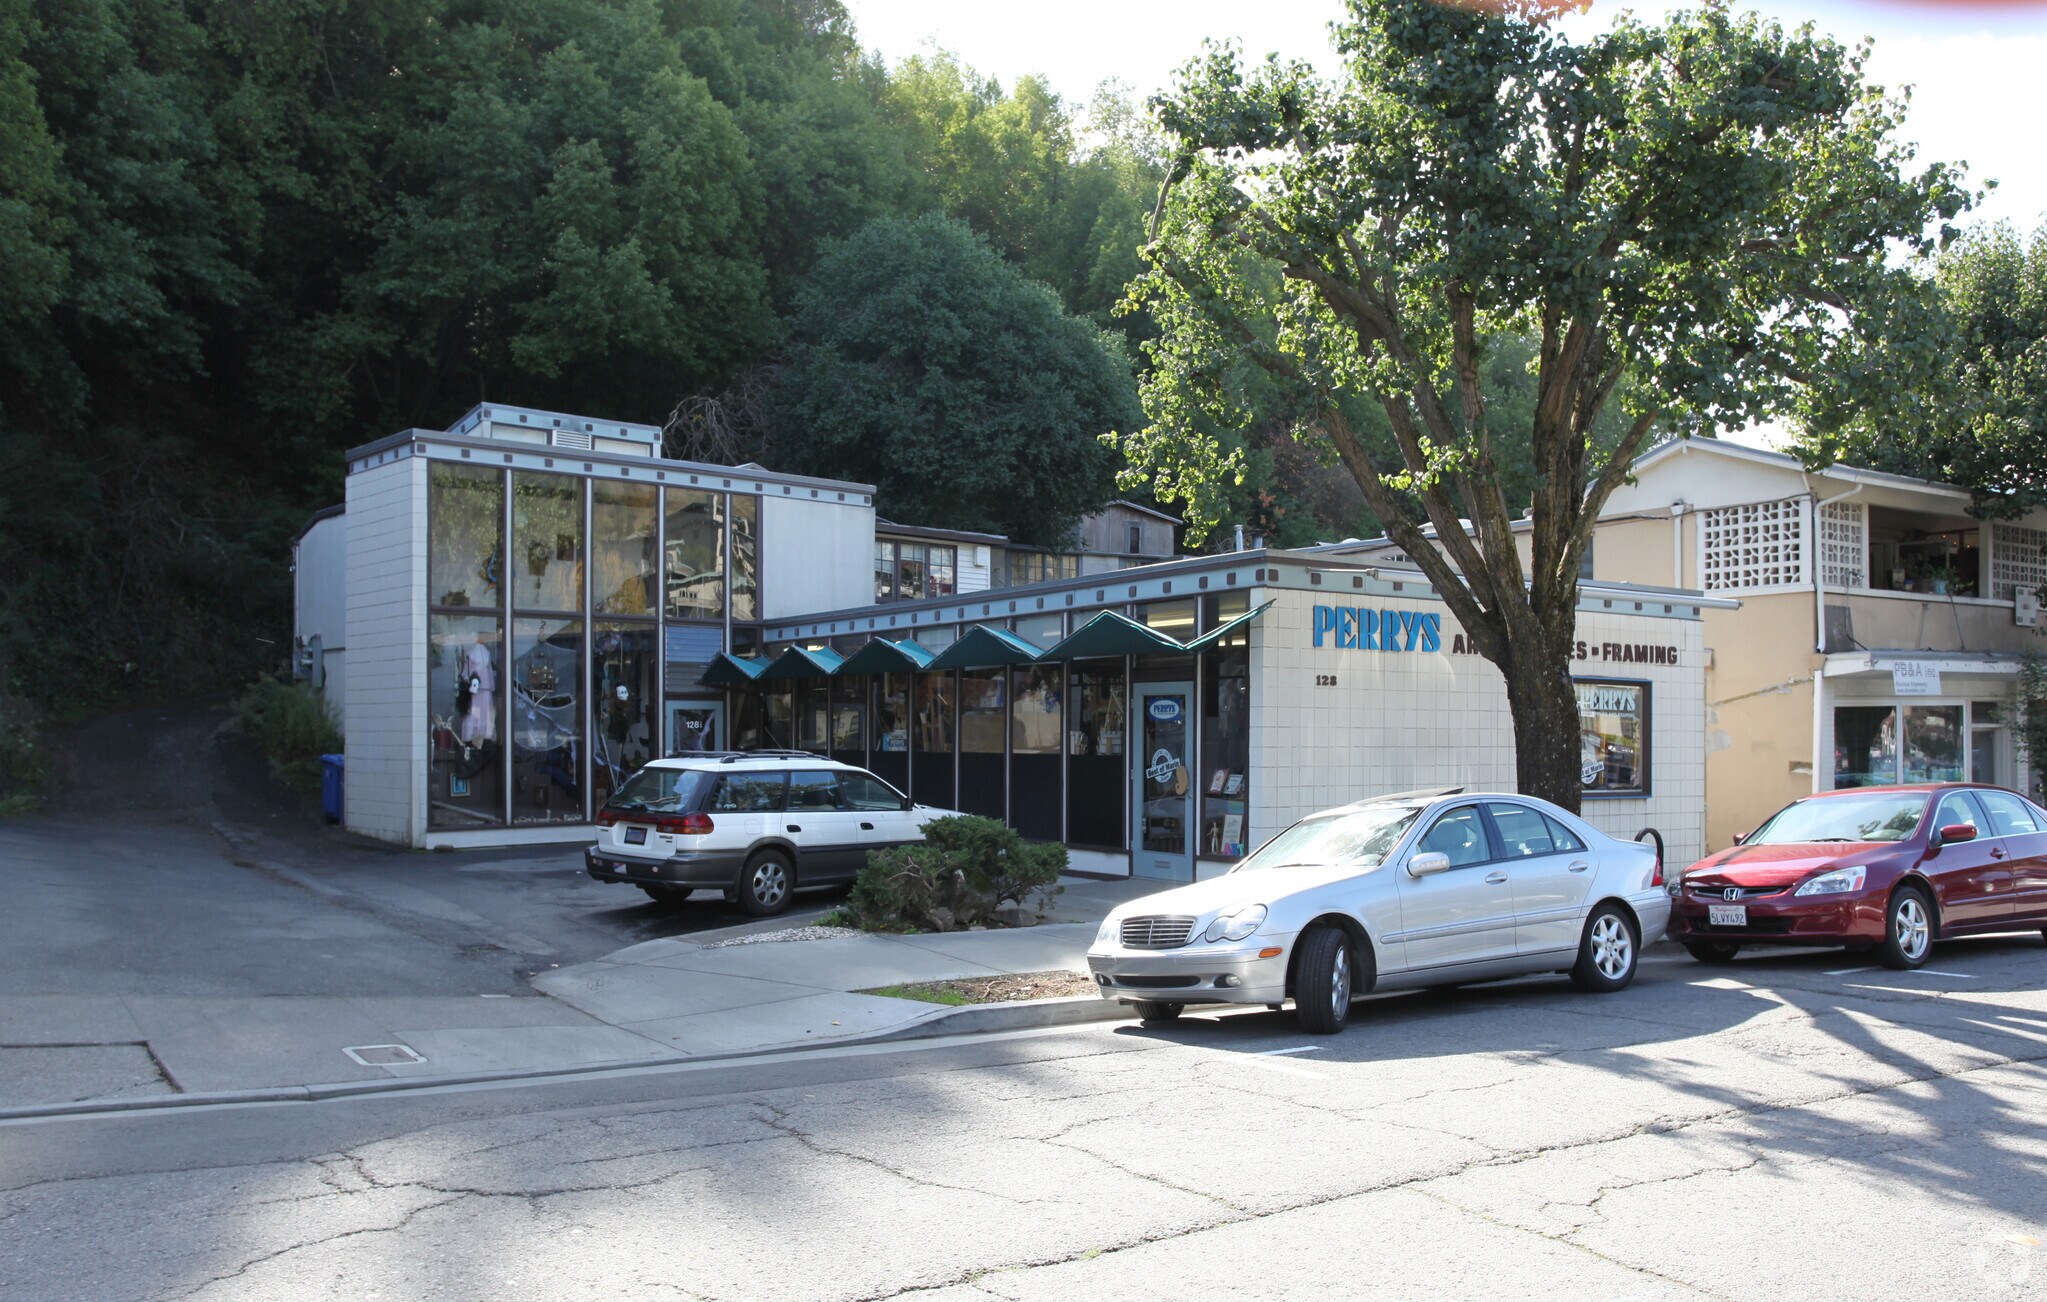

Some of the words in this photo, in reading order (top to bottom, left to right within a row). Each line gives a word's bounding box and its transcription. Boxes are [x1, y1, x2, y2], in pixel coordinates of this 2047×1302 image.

[1313, 605, 1441, 652] PERRYS
[1603, 642, 1677, 664] FRAMING
[1894, 662, 1922, 677] PB&A
[1316, 675, 1337, 686] 128
[1581, 689, 1636, 711] PERRYS
[686, 720, 700, 728] 128
[1711, 913, 1744, 924] 5LVY492
